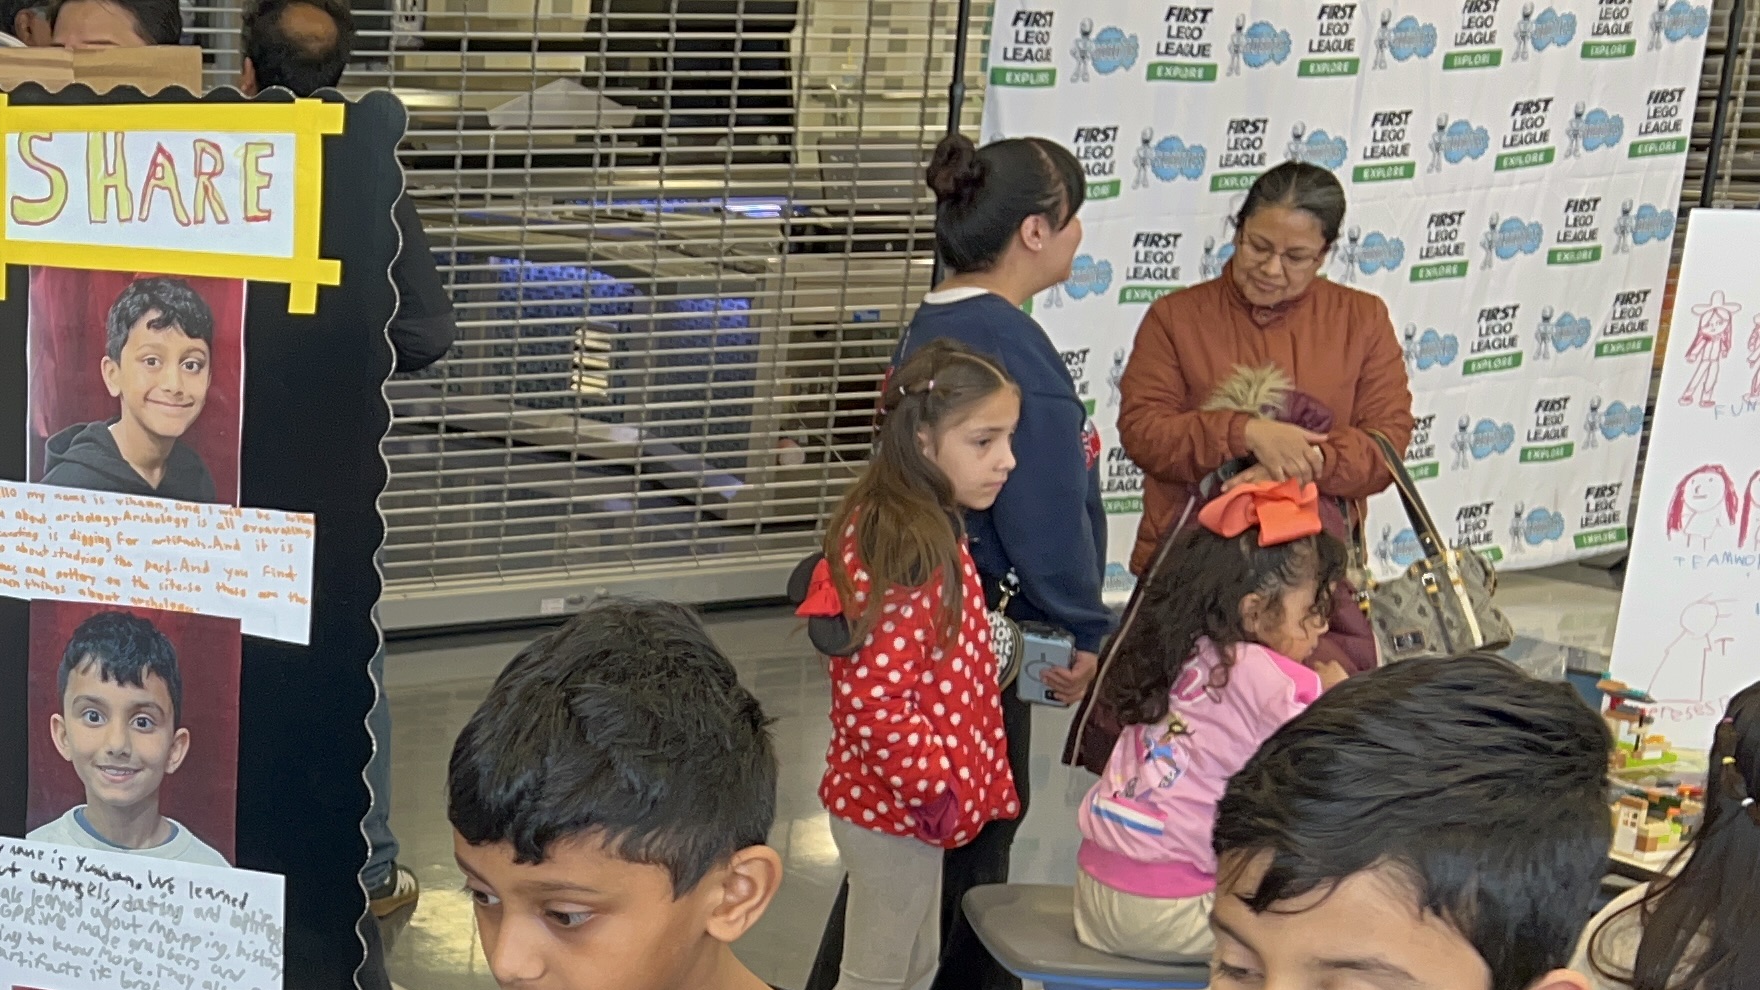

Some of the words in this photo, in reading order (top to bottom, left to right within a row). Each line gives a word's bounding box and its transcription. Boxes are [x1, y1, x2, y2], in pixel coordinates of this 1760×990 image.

[1164, 6, 1213, 23] FIRST
[1167, 25, 1203, 40] LEGO
[1156, 42, 1211, 58] LEAGUE
[1156, 66, 1205, 79] EXPLORE
[1511, 98, 1553, 117] FIRST
[1371, 110, 1412, 127] FIRST
[1512, 116, 1545, 131] LEGO
[1372, 128, 1405, 143] LEGO
[1502, 131, 1551, 149] LEAGUE
[1363, 143, 1411, 159] LEAGUE
[1502, 152, 1545, 167] EXPLORE
[10, 131, 275, 227] SHARE
[1363, 165, 1405, 178] EXPLORE
[1477, 304, 1520, 323] FIRST
[1479, 322, 1513, 338] LEGO
[1470, 336, 1519, 353] LEAGUE
[1471, 356, 1514, 372] EXPLORE
[1714, 402, 1759, 420] FUN
[51, 849, 67, 872] is
[148, 870, 175, 895] We
[189, 881, 249, 910] learned
